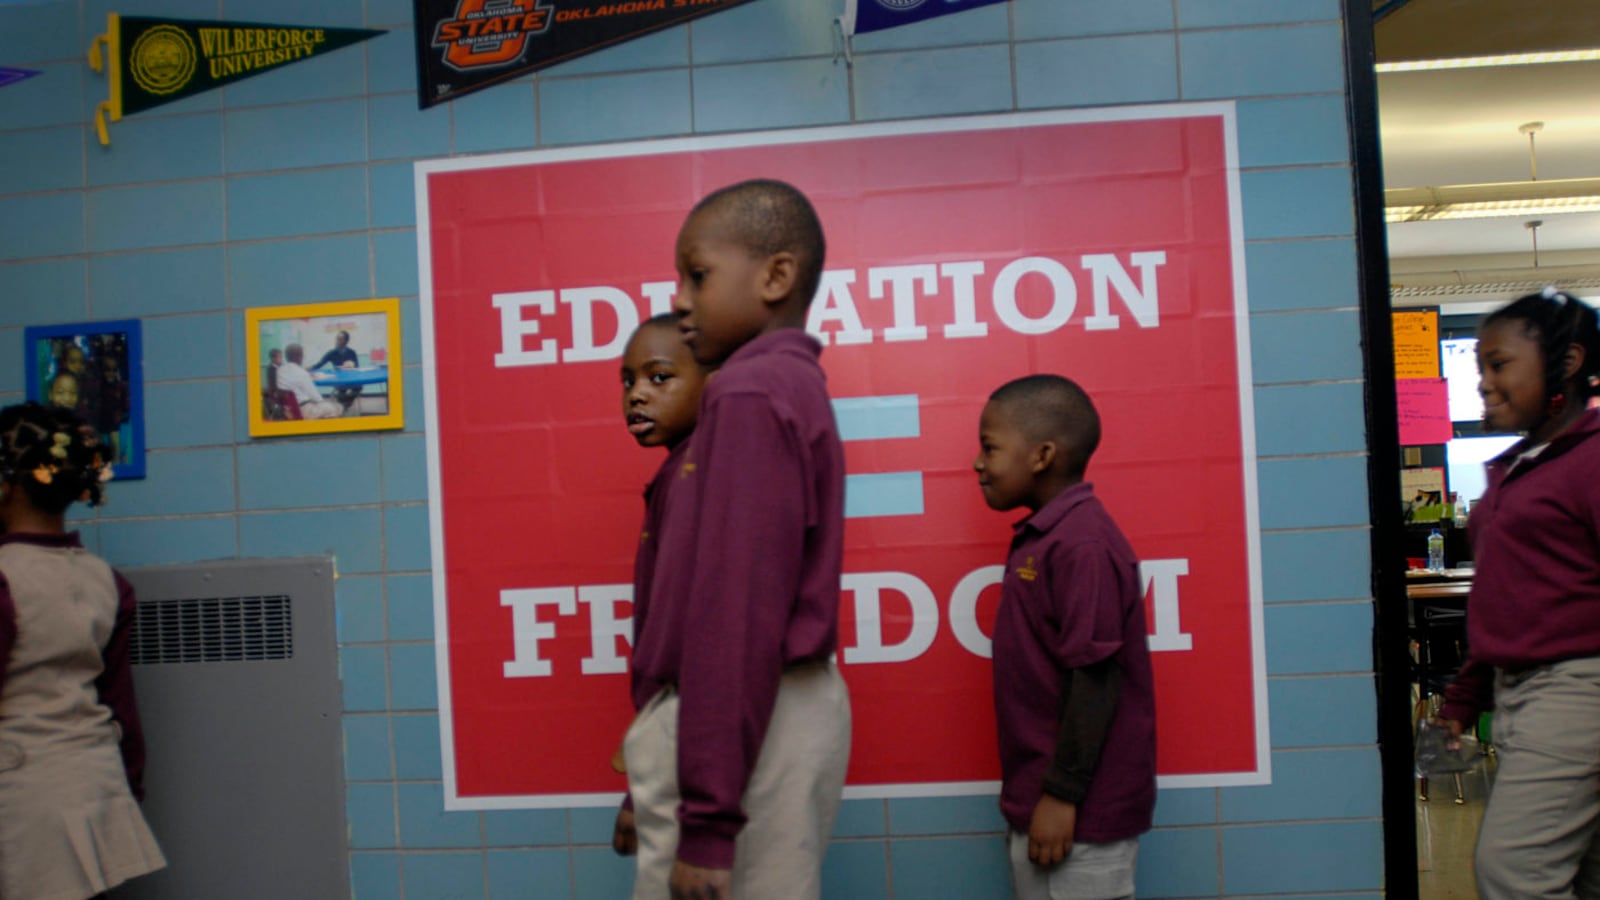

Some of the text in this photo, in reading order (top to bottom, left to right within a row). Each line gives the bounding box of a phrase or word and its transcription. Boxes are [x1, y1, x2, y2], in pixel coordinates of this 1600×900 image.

[467, 6, 524, 20] OKLAHOMA
[555, 0, 665, 22] OKLAHOMA
[438, 11, 547, 41] STATE
[458, 31, 520, 46] UNIVERSITY
[198, 28, 325, 57] WILBERFORCE
[209, 44, 314, 78] UNIVERSITY
[492, 251, 1166, 368] EDATION
